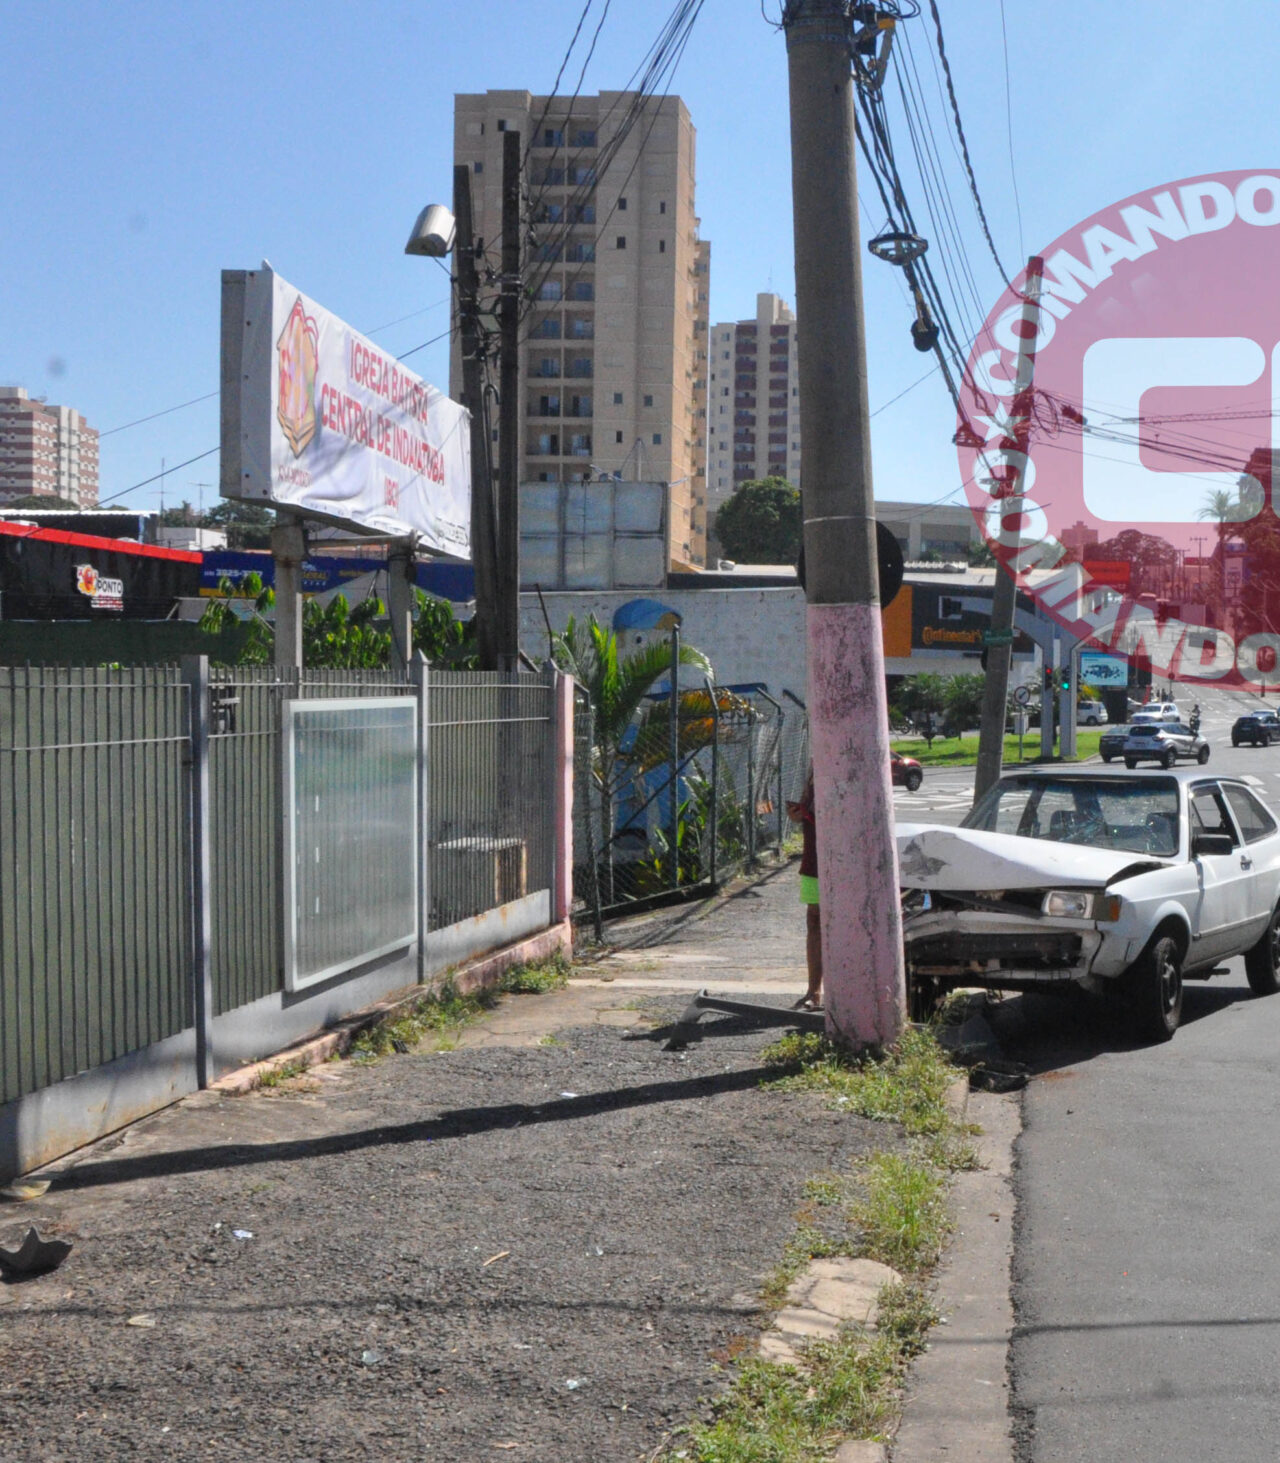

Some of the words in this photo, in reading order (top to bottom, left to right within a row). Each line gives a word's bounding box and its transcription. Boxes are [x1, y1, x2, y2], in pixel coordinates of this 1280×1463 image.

[321, 382, 375, 449] CENTRAL
[377, 413, 391, 457] DE
[350, 339, 390, 400] IGREJA
[391, 366, 428, 425] BATISTA
[97, 579, 122, 594] PONTO
